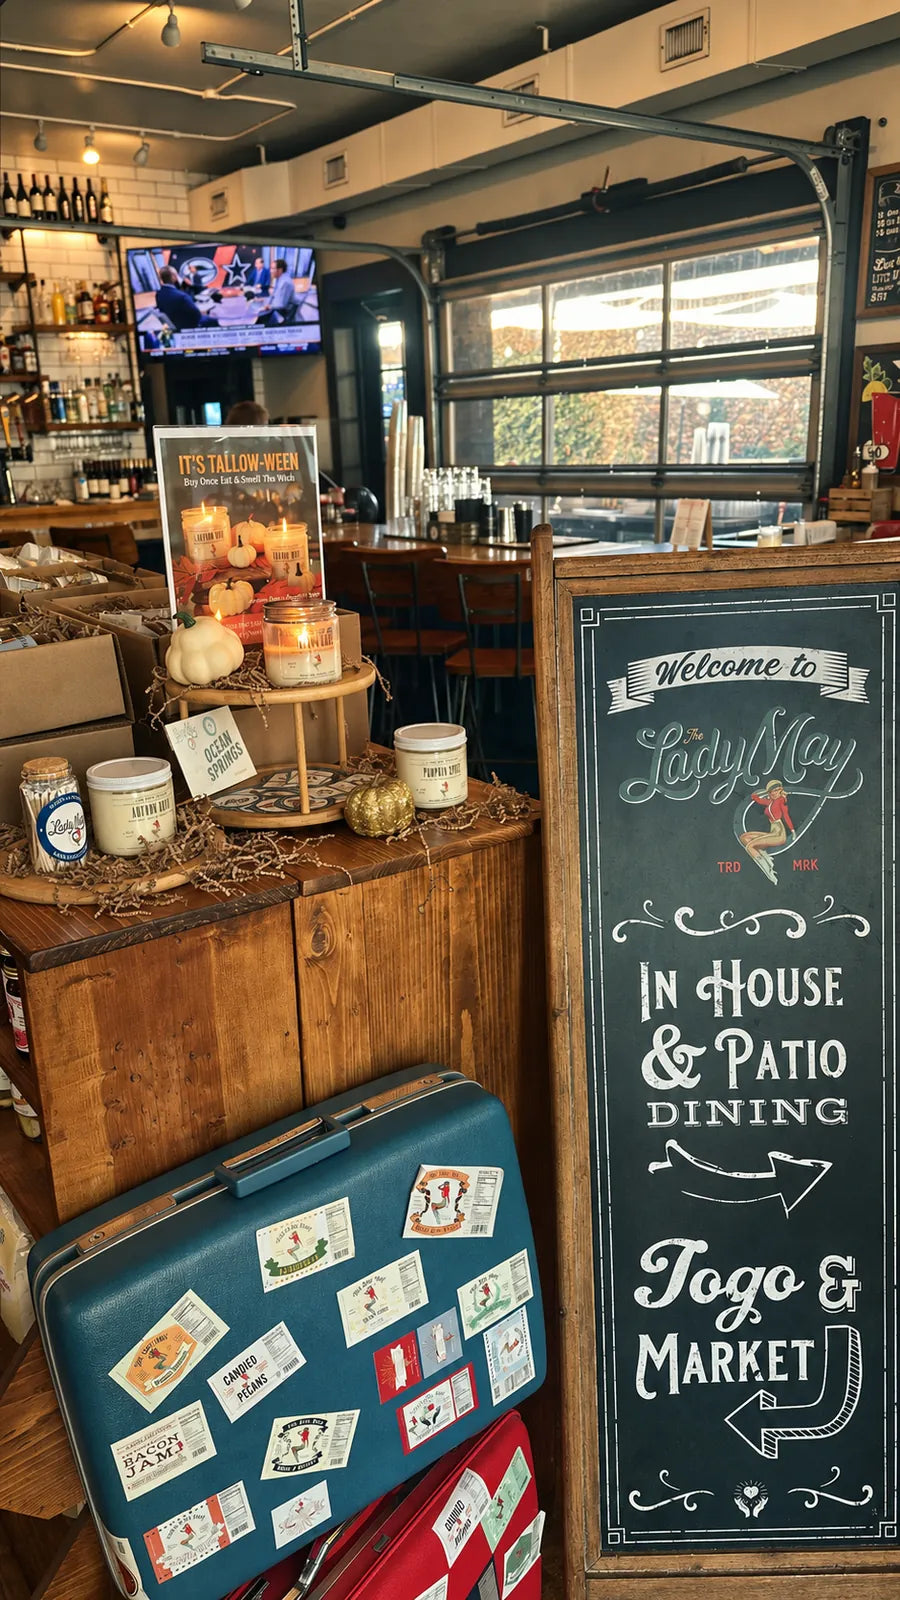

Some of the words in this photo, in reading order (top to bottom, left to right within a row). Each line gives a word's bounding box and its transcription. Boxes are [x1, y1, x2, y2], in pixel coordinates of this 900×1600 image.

[178, 454, 206, 475] IT'S
[207, 452, 299, 474] TALLOW-WEEN
[184, 478, 198, 488] Buy
[200, 477, 218, 486] Once
[234, 476, 240, 484] &
[656, 652, 783, 686] Welcome
[793, 654, 817, 678] to
[204, 730, 233, 763] OCEAN
[684, 727, 704, 744] The
[208, 742, 243, 782] SPRINGS
[619, 721, 747, 805] Lady
[743, 706, 864, 804] May
[717, 862, 741, 873] TRD
[793, 859, 818, 871] MRK
[639, 961, 678, 1023] IN
[696, 959, 844, 1018] HOUSE
[641, 1024, 707, 1090] &
[714, 1028, 848, 1090] PATIO
[647, 1098, 848, 1128] DINING
[634, 1237, 805, 1333] Togo
[818, 1254, 862, 1314] &
[223, 1355, 258, 1386] CANDIED
[636, 1332, 814, 1400] MARKET
[237, 1374, 268, 1402] PECANS
[123, 1432, 179, 1468] BACON
[126, 1446, 175, 1478] JAM
